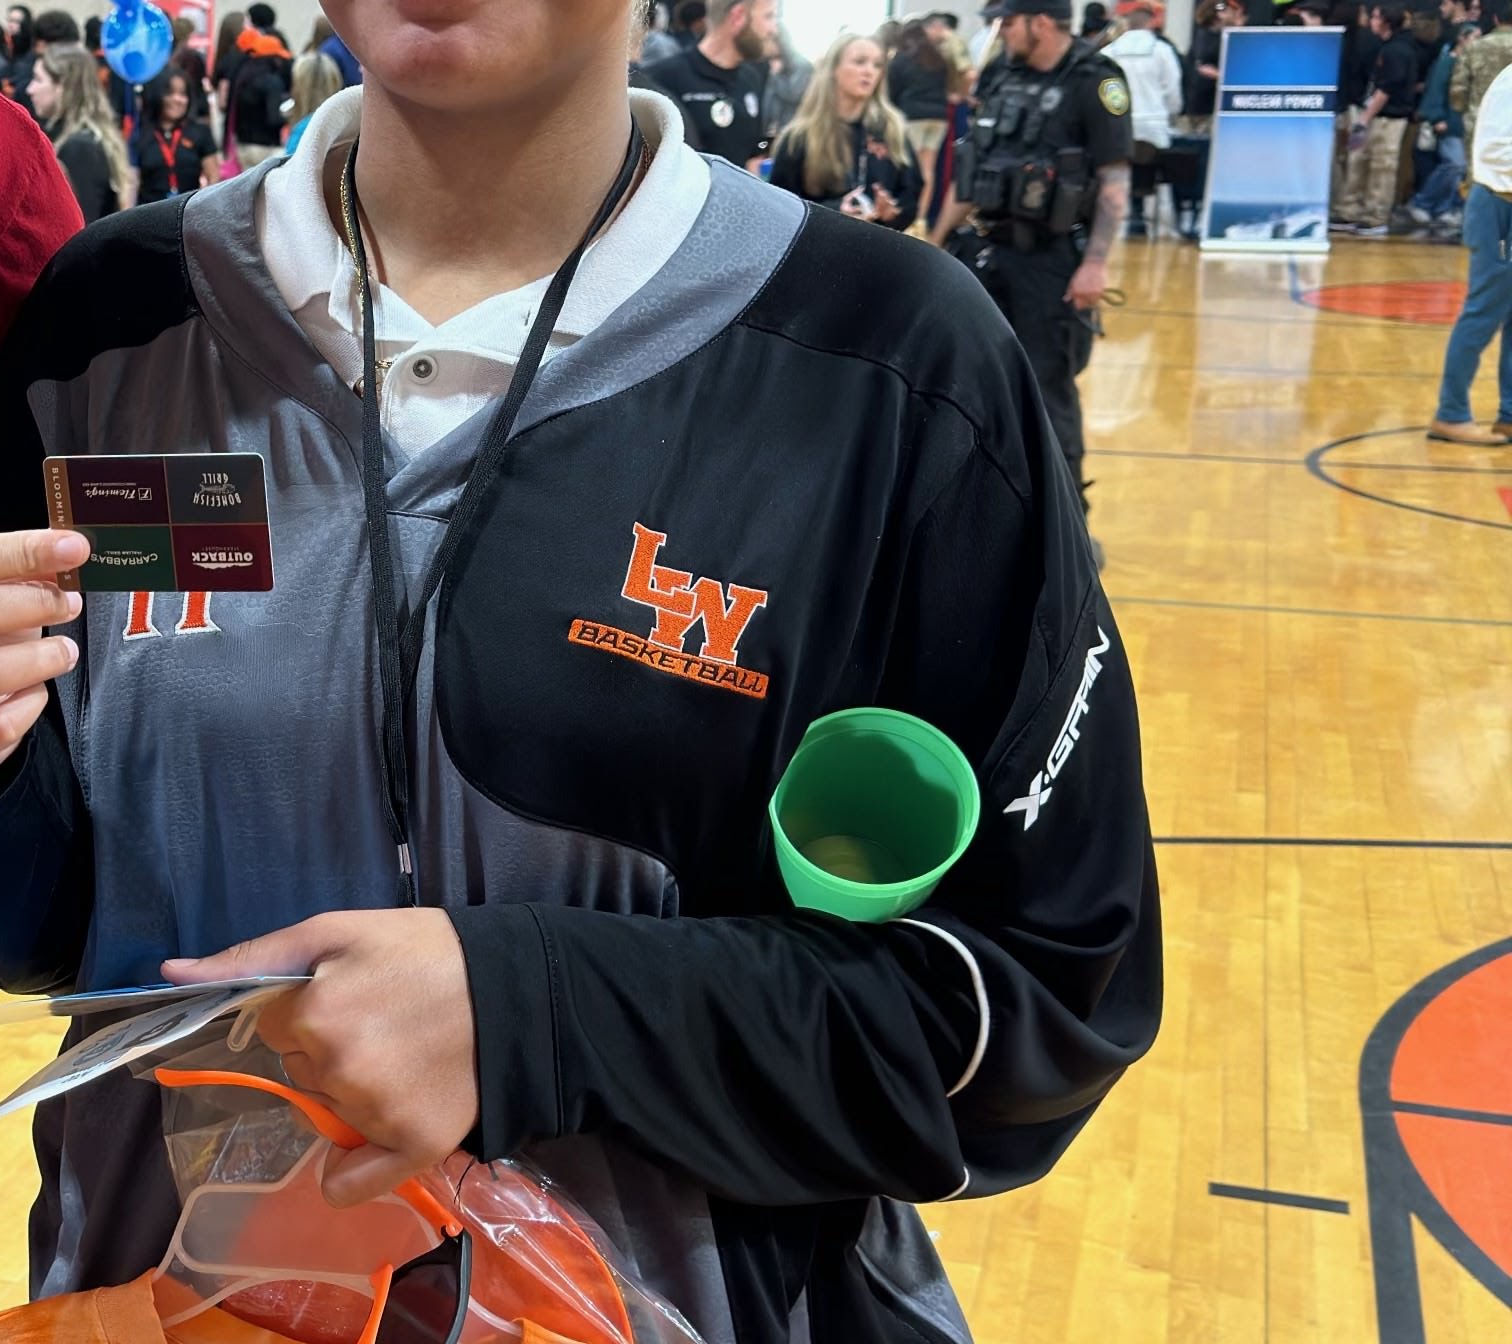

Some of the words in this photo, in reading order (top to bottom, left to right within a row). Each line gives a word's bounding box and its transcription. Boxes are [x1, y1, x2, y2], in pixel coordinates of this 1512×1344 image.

[1232, 94, 1283, 109] NUCLEAR
[1284, 94, 1325, 110] POWER
[202, 473, 228, 484] GRILL
[51, 466, 65, 527] BLOOMIN'
[84, 487, 136, 499] Fleming's
[193, 492, 242, 507] BONEFISH
[90, 553, 158, 566] CARRABBA'S
[192, 552, 254, 562] OUTBACK
[621, 521, 768, 666] LW
[576, 622, 765, 694] BASKETBALL
